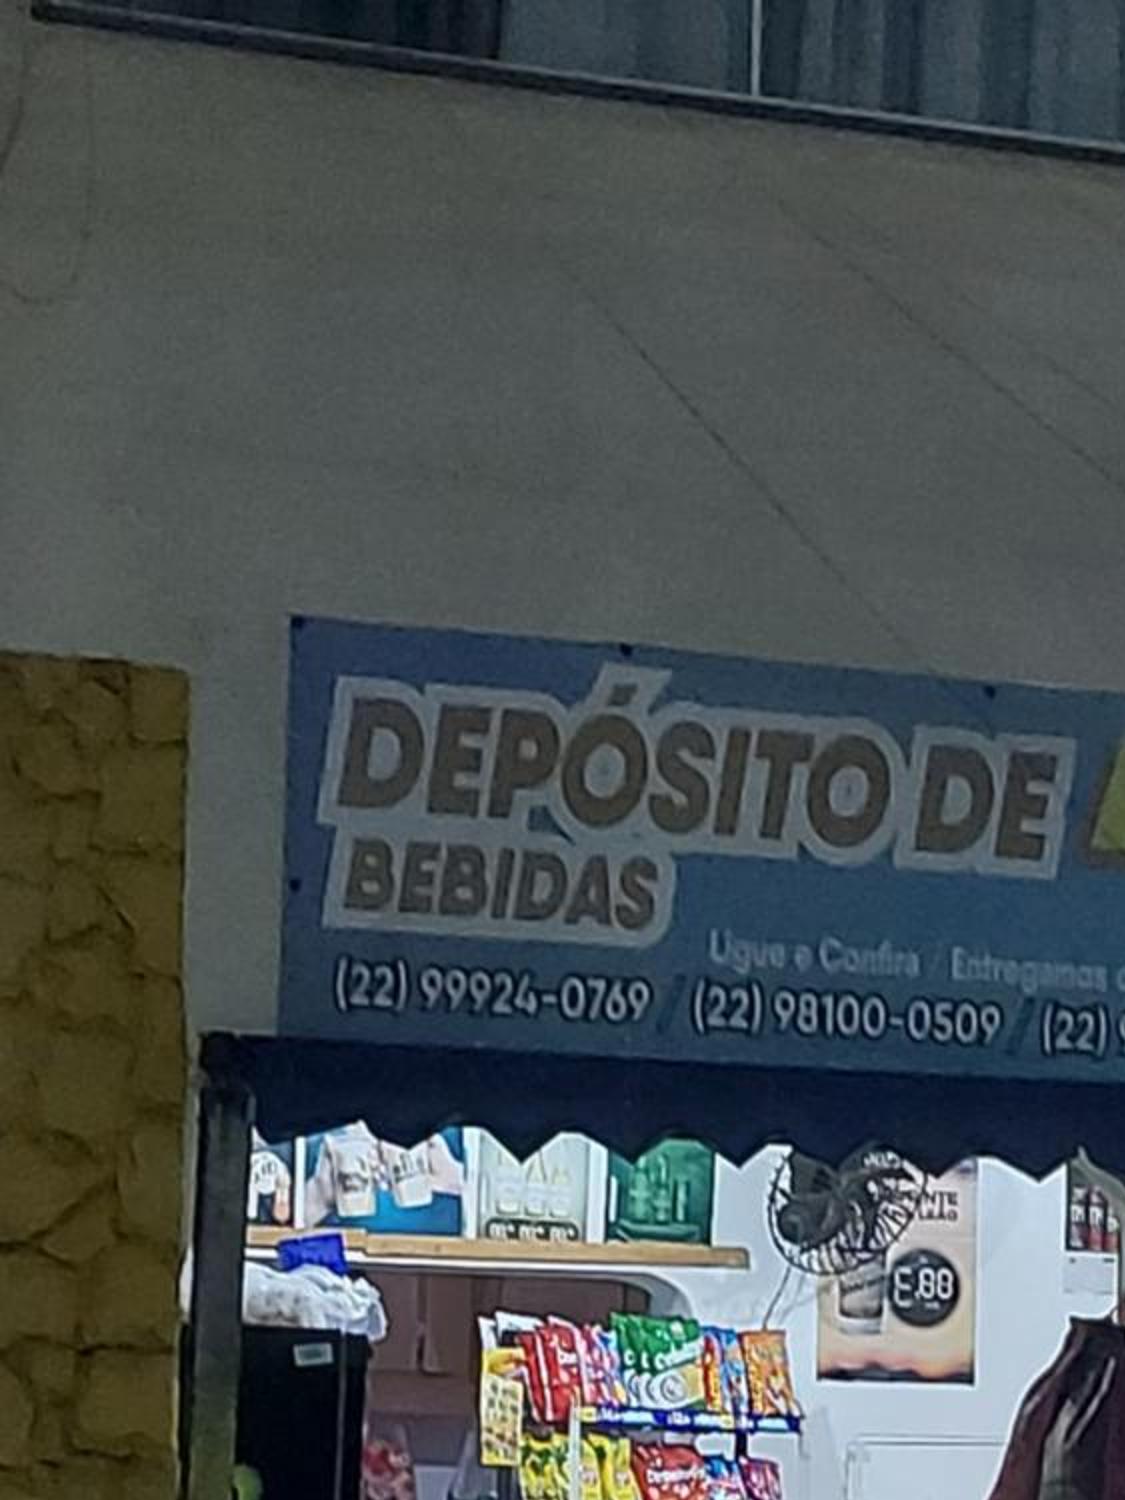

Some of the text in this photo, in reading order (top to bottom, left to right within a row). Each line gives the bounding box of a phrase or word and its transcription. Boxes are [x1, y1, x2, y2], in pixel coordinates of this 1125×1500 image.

[337, 683, 1059, 861] DEPÓSITO DE
[342, 838, 660, 930] BEBIDAS
[709, 929, 784, 971] Ligue
[795, 947, 811, 967] e
[819, 937, 921, 979] Confira
[334, 957, 406, 1014] (22)
[421, 967, 653, 1023] 99924-0769
[692, 980, 761, 1033] (22)
[772, 991, 1003, 1047] 98100-0509
[1042, 1003, 1107, 1056] (22)
